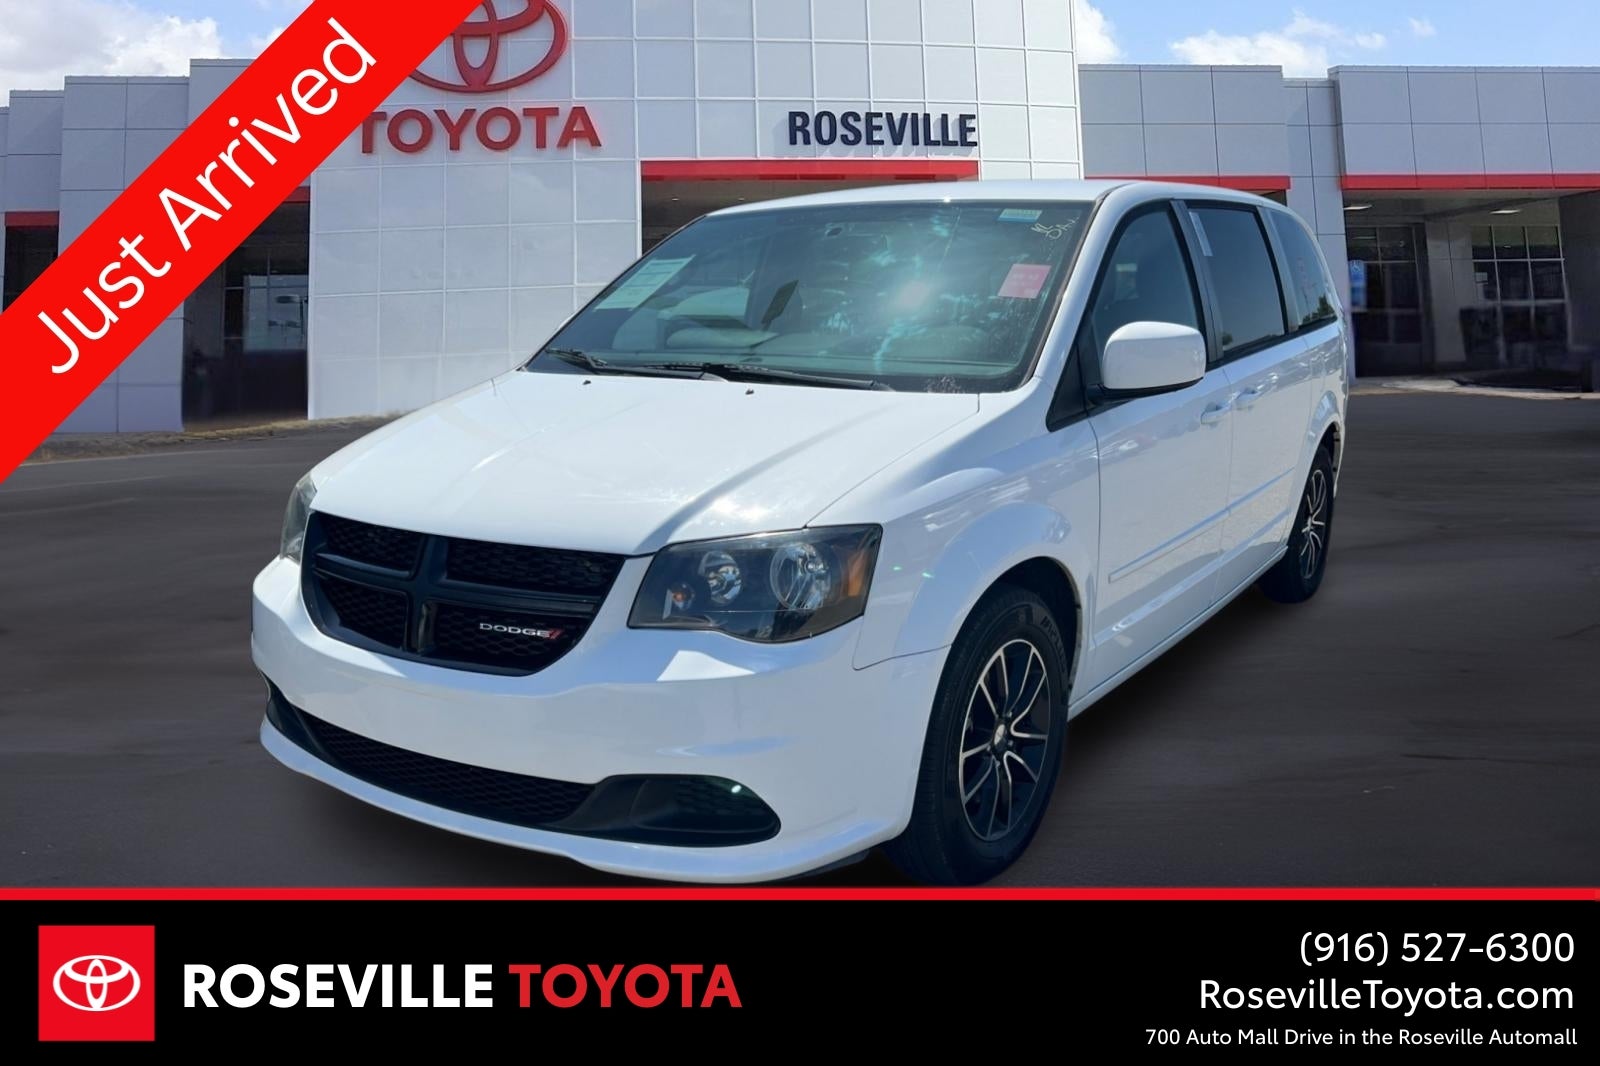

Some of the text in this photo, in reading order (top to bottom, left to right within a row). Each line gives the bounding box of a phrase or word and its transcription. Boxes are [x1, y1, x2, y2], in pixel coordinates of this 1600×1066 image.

[361, 106, 602, 155] TOYOTA
[788, 110, 978, 147] ROSEVILLE
[479, 622, 550, 639] DODGE
